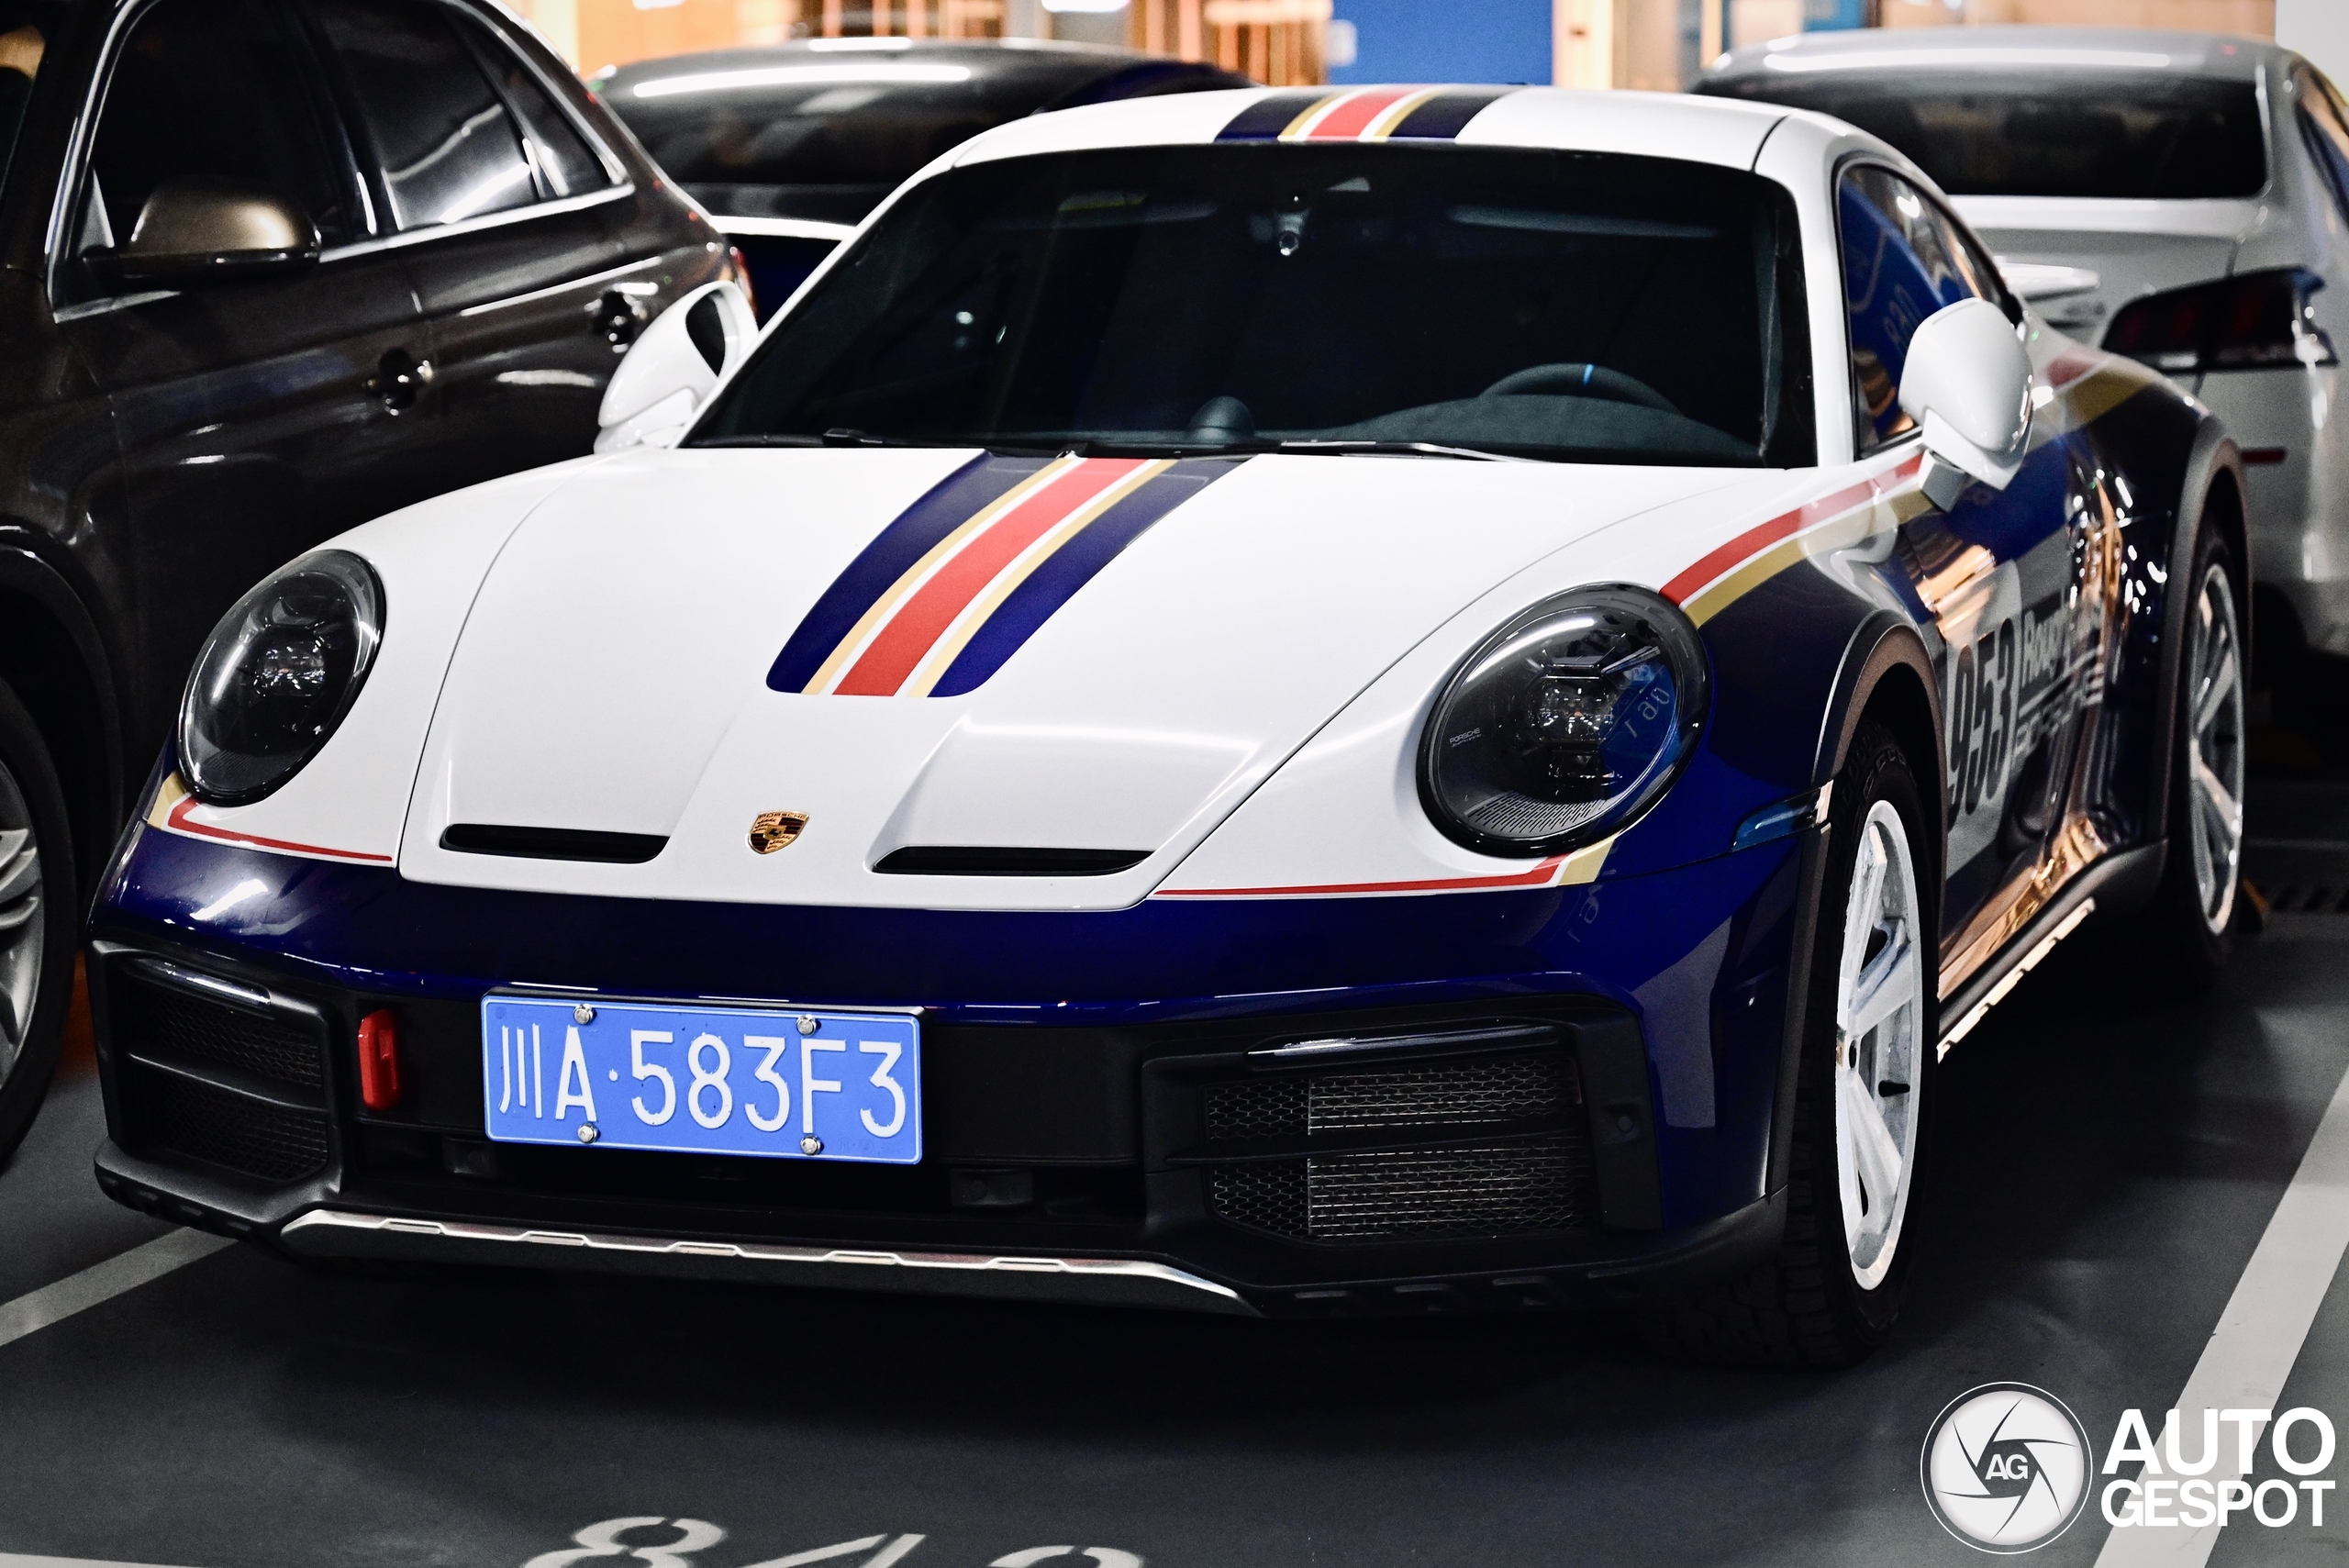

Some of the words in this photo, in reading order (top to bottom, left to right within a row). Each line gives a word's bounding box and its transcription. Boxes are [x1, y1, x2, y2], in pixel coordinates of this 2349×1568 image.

[1449, 727, 1481, 744] PORSCHE
[1946, 617, 2015, 828] 953
[498, 1022, 907, 1138] 川A·583F3
